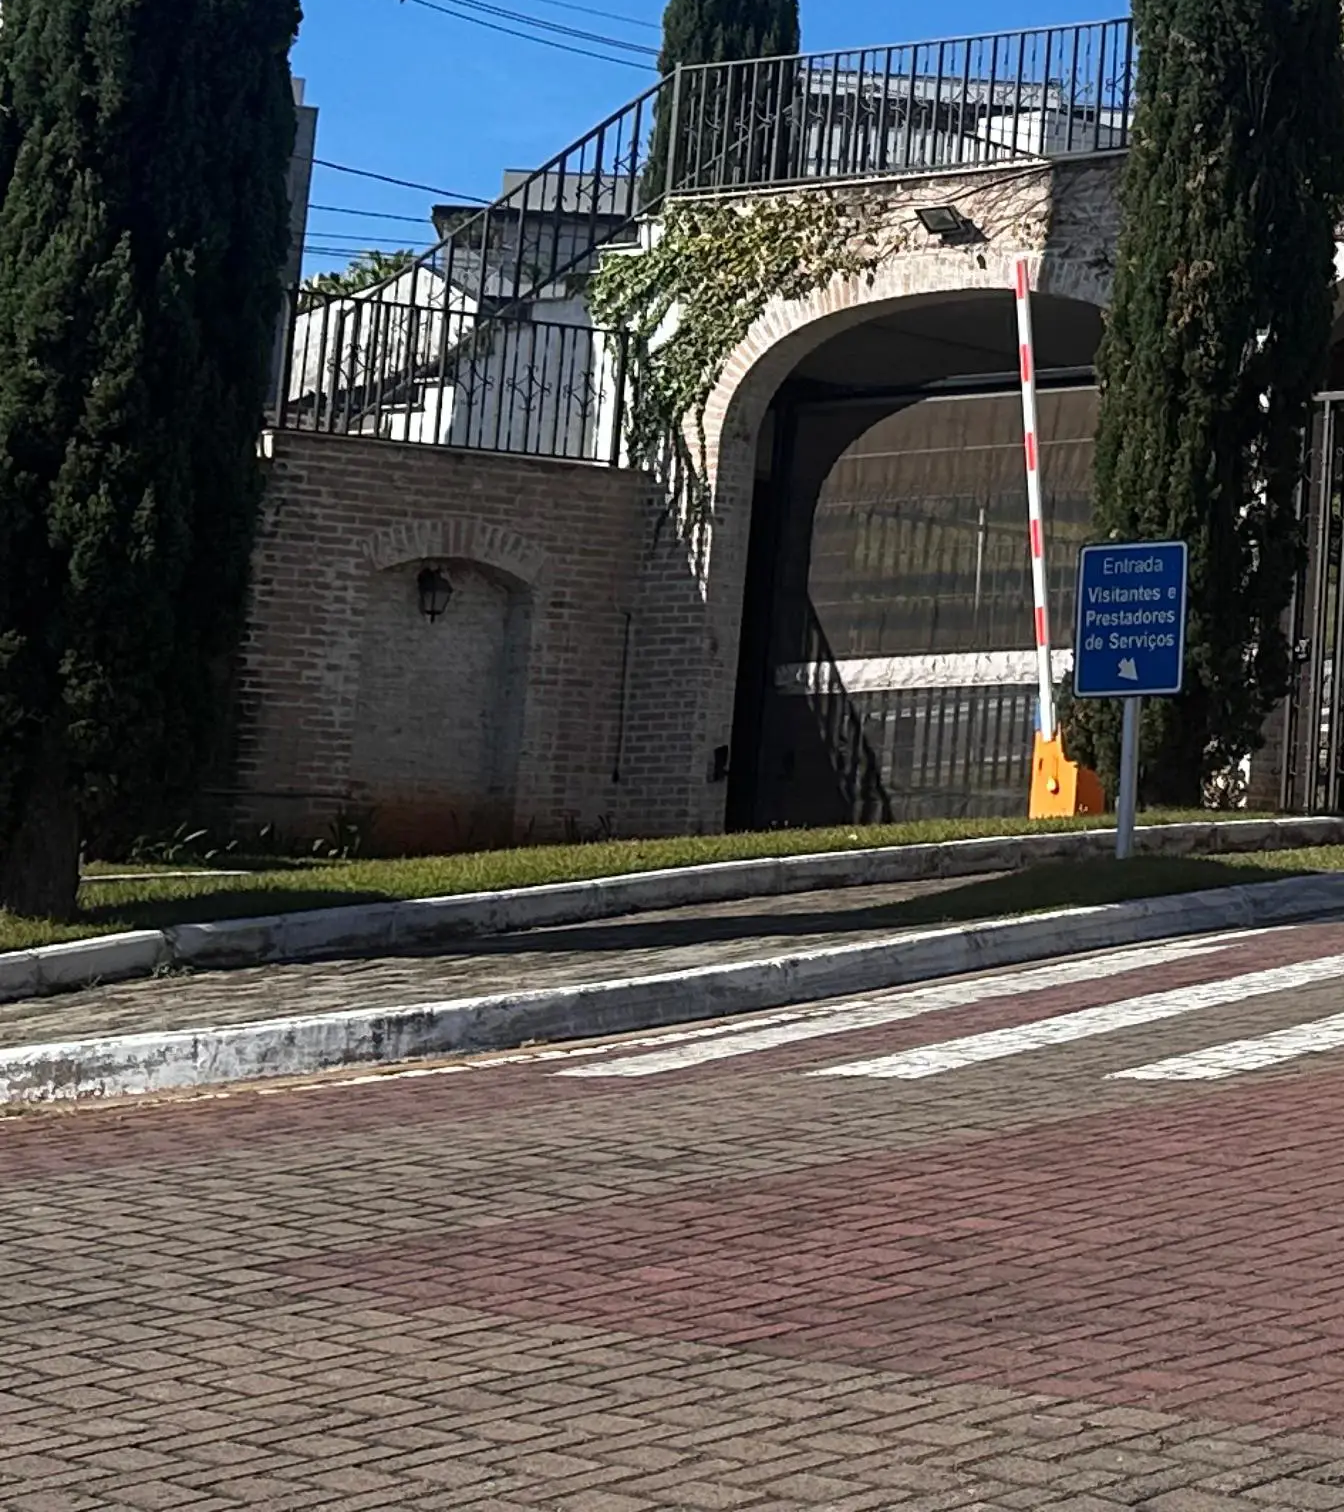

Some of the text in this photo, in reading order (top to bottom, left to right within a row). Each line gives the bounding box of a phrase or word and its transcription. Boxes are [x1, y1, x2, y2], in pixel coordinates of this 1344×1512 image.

[1103, 556, 1163, 575] Entrada
[1088, 585, 1177, 604] Visitantes e
[1086, 609, 1175, 627] Prestadores
[1084, 630, 1175, 651] de Serviços
